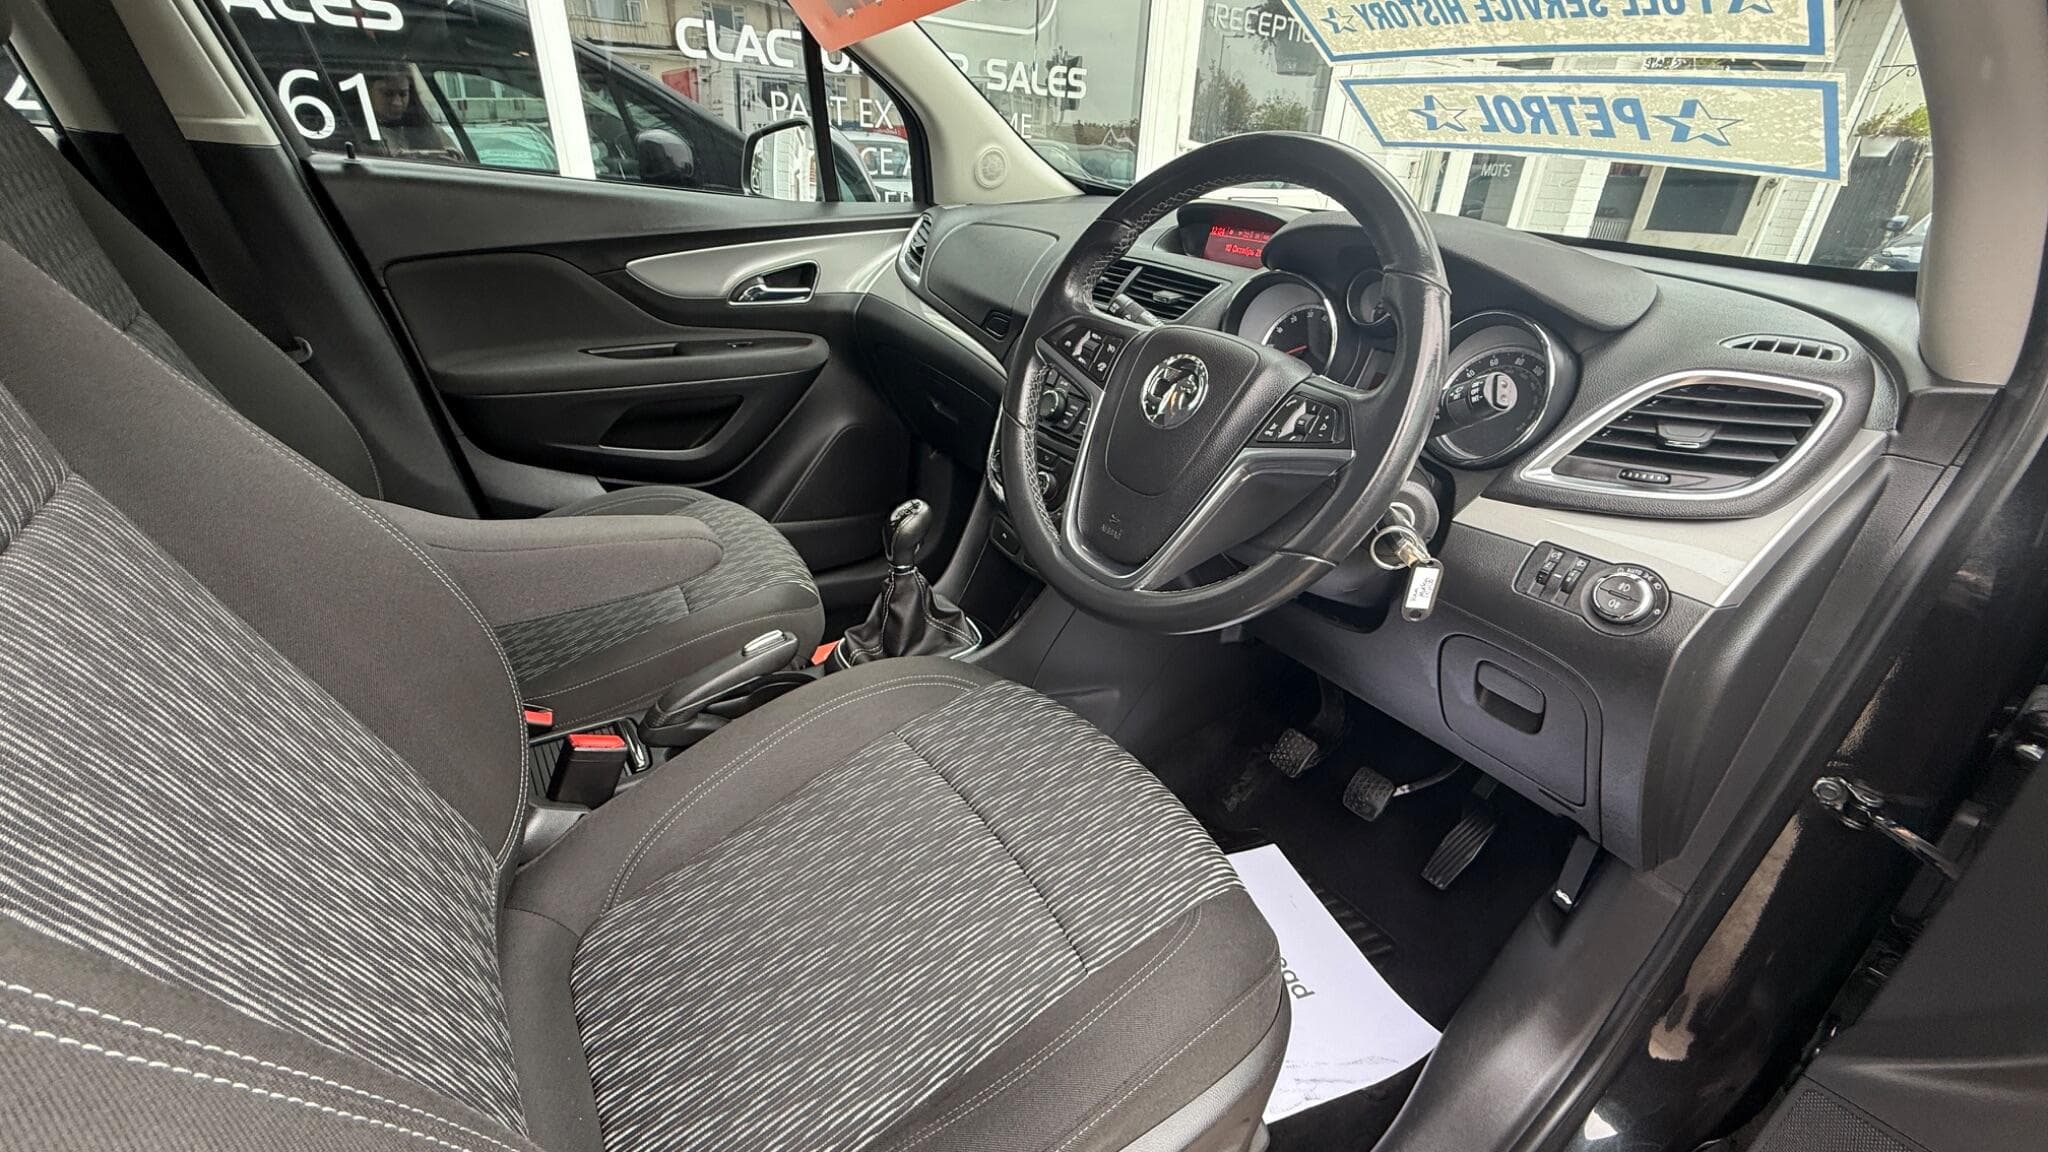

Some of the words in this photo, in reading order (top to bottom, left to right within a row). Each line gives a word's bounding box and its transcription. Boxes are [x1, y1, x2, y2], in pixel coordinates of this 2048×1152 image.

[986, 58, 1088, 99] SALES
[278, 69, 382, 141] 61
[770, 91, 847, 126] PAT
